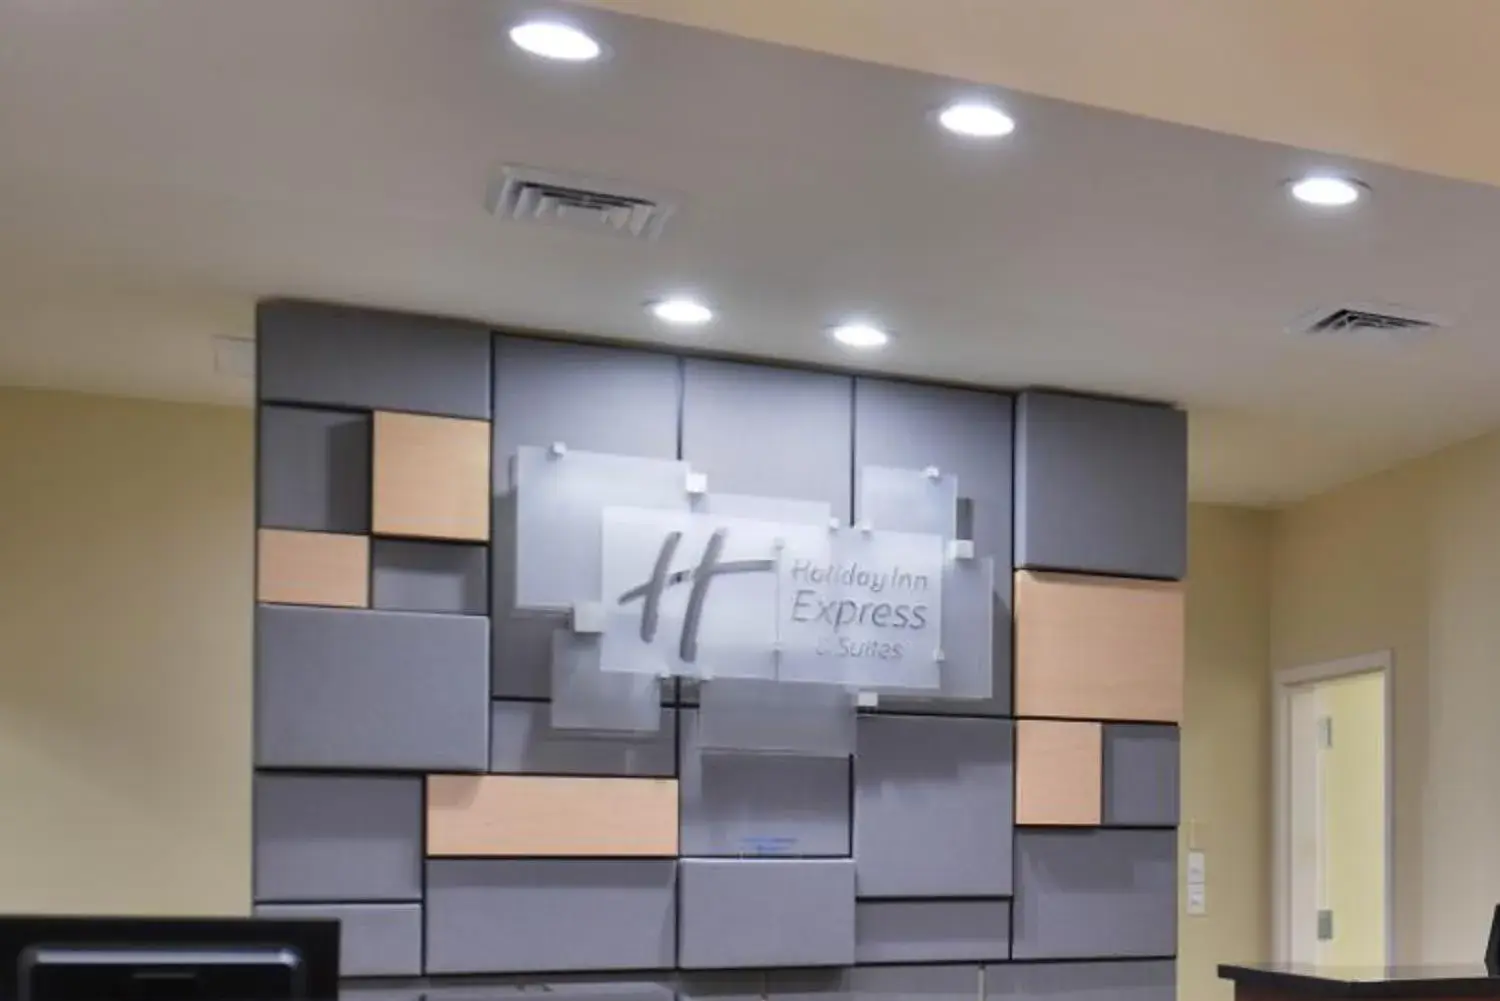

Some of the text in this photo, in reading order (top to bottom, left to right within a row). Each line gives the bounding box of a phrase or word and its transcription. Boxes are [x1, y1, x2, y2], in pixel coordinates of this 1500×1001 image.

[791, 558, 928, 592] Holiday Inn
[790, 589, 928, 633] Express
[837, 637, 904, 660] Suites
